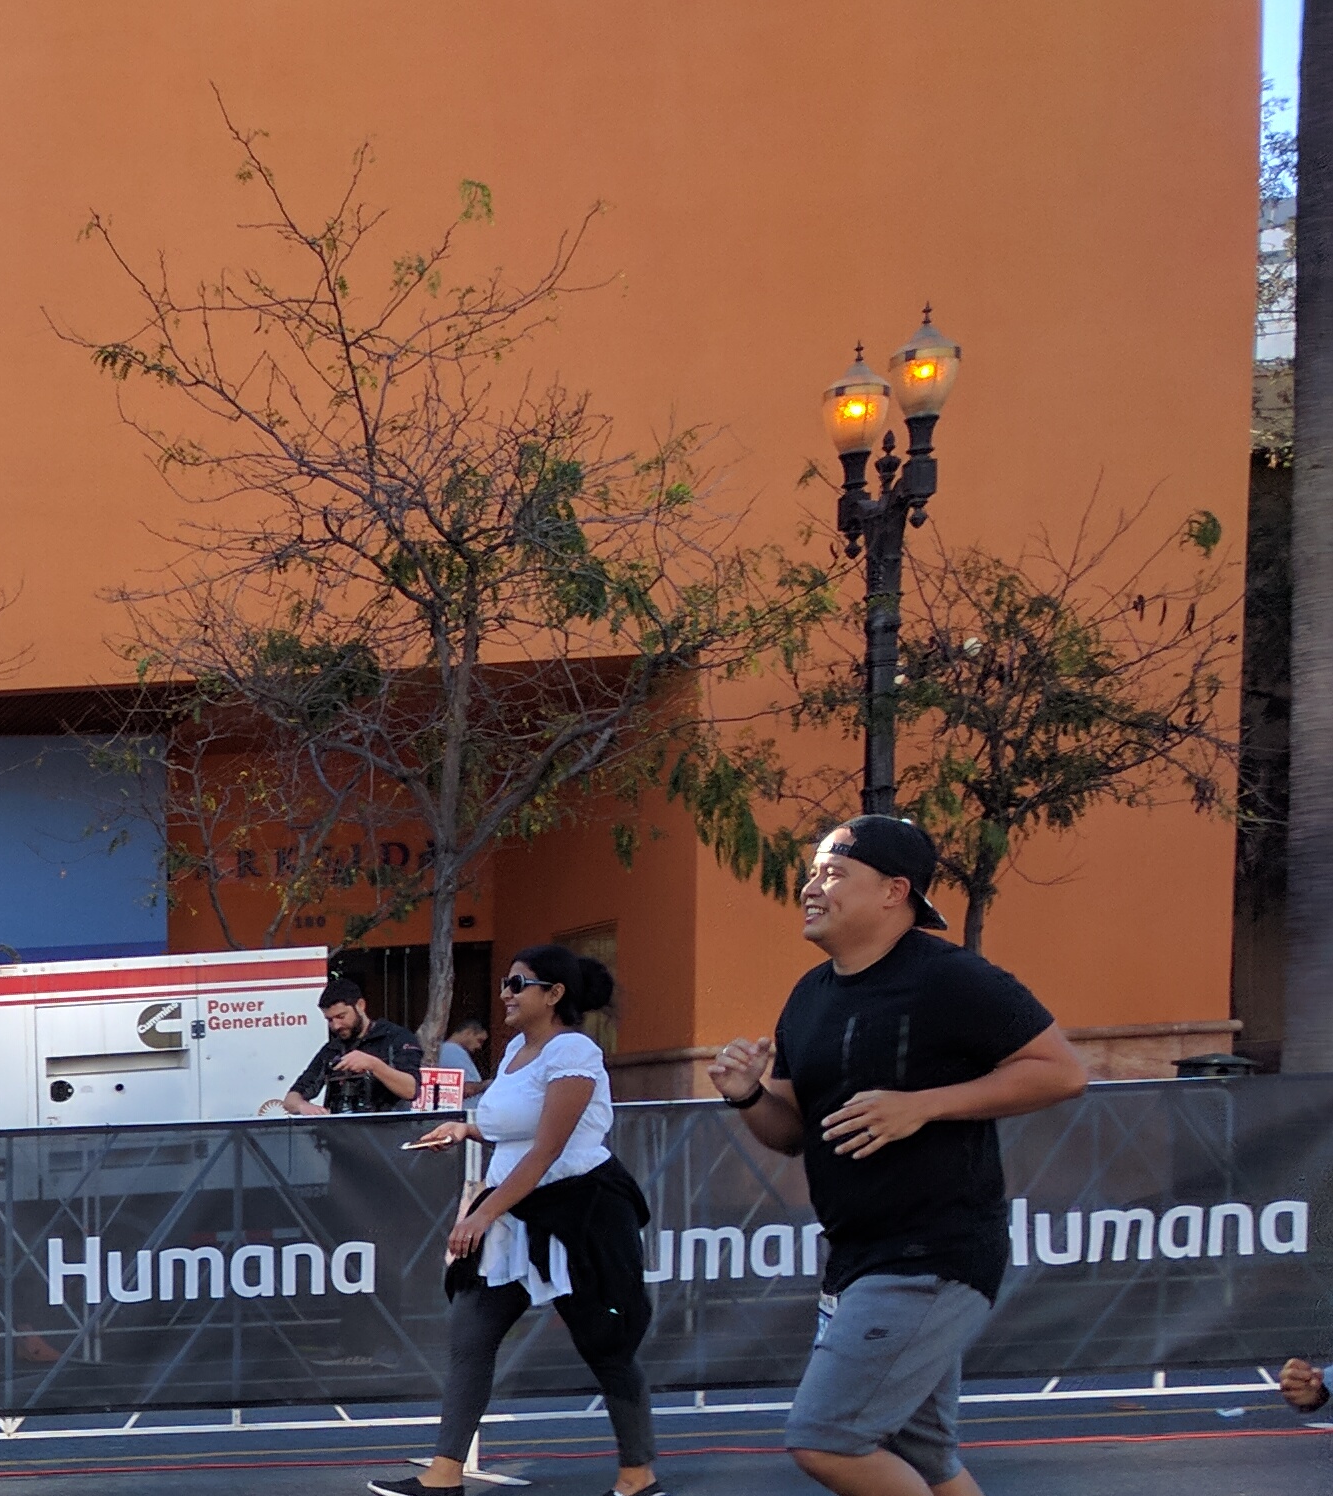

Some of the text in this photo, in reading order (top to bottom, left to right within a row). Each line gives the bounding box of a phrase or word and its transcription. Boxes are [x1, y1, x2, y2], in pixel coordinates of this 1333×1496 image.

[137, 1002, 179, 1034] Cummins
[207, 1000, 265, 1014] Power
[207, 1012, 308, 1031] Generation
[47, 1236, 377, 1306] Humana
